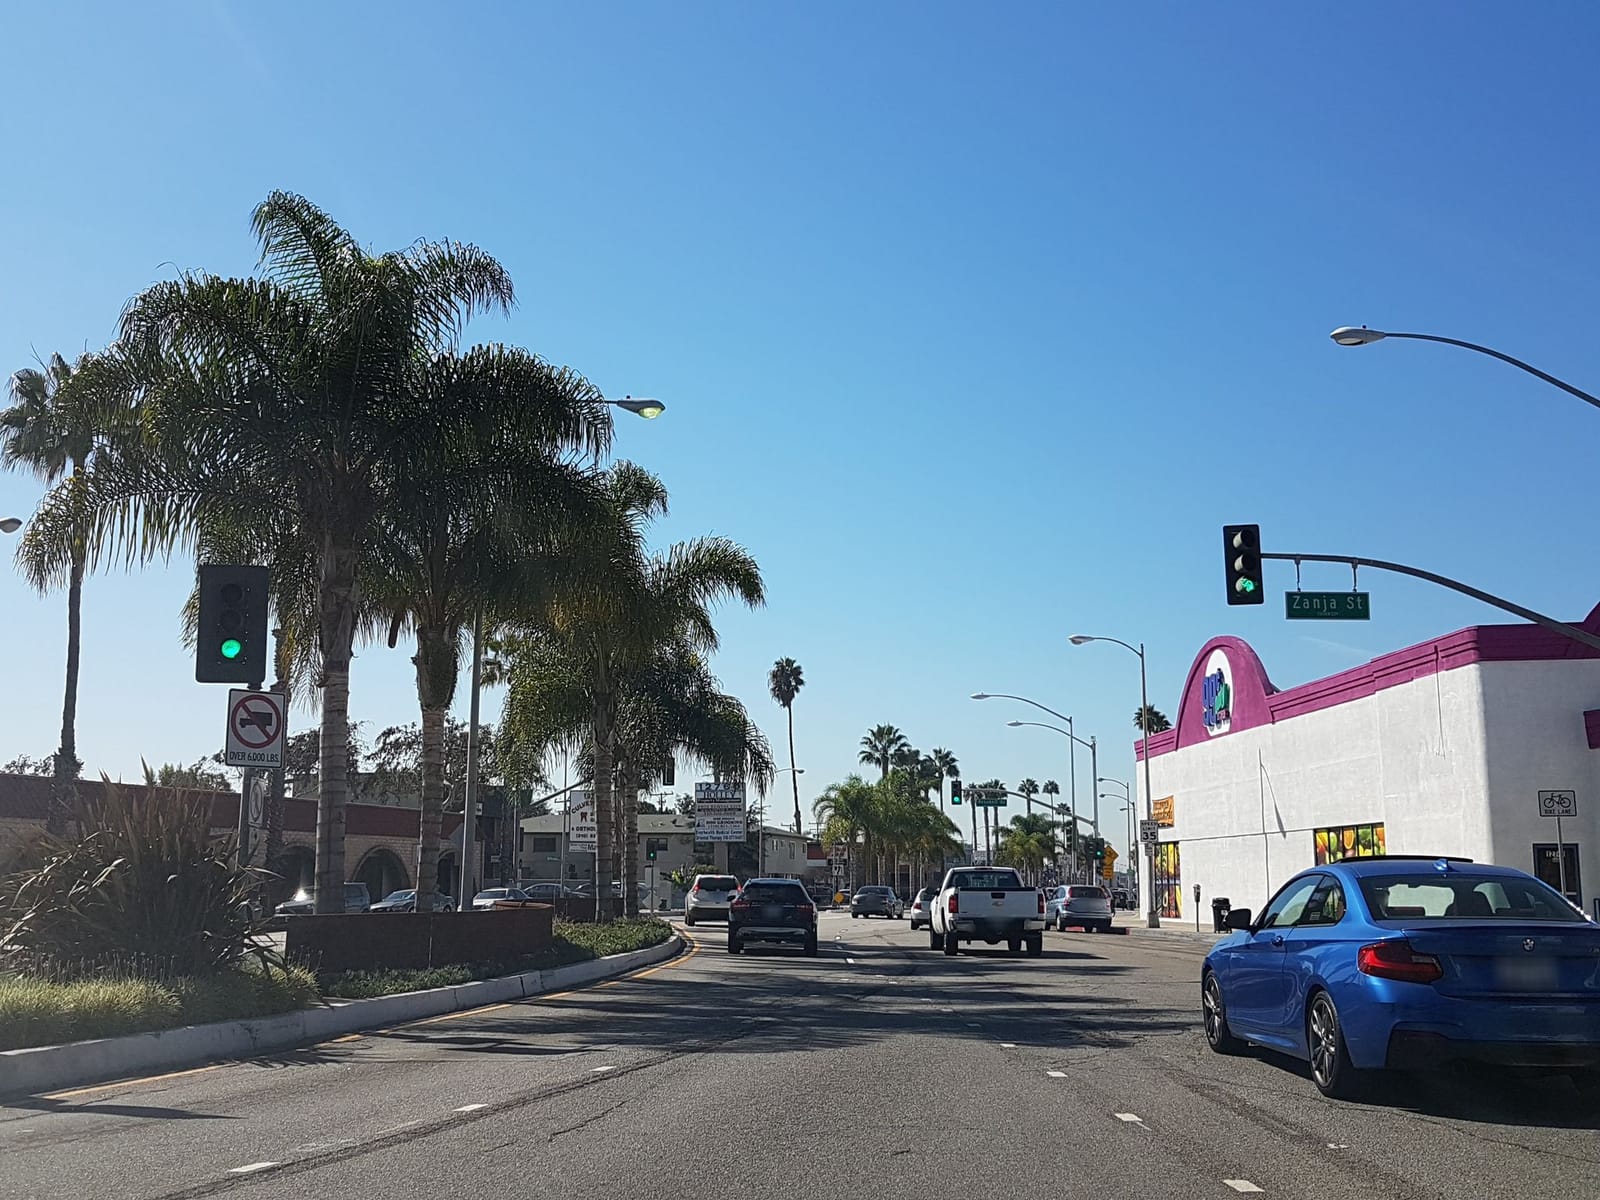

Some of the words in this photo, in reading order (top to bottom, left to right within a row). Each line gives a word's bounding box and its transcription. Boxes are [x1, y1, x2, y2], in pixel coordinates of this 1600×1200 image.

[1292, 595, 1337, 612] Zanja
[1346, 596, 1362, 609] St
[229, 751, 246, 761] OVER
[1143, 832, 1156, 840] 35
